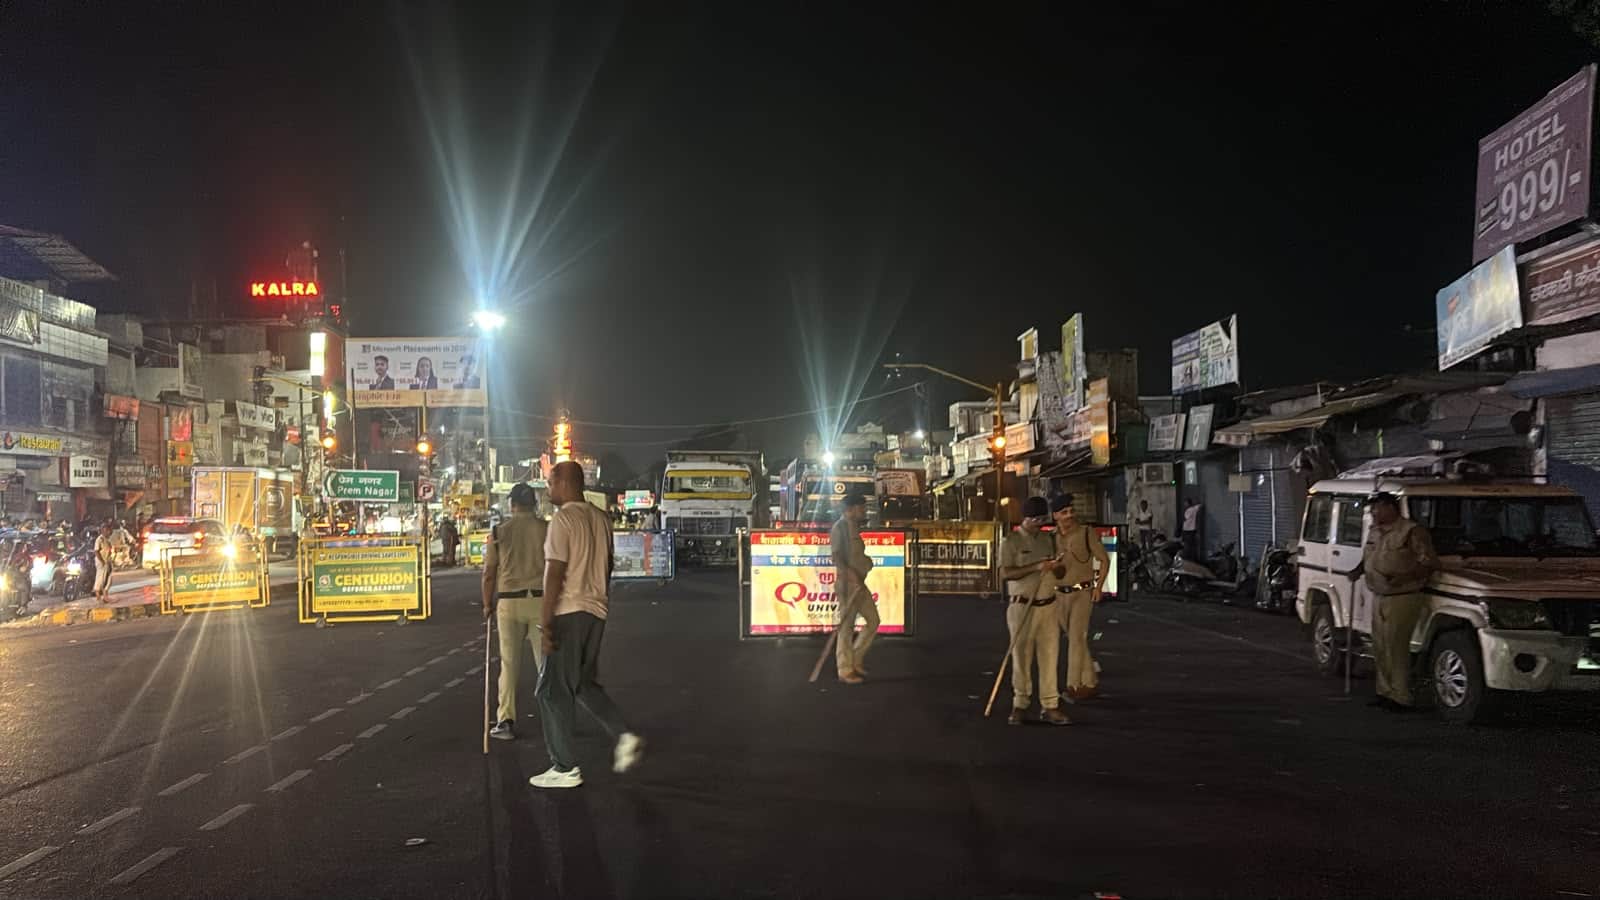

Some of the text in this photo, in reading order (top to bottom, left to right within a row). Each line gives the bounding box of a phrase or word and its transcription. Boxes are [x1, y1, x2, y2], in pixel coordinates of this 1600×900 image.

[1495, 112, 1567, 171] HOTEL
[251, 281, 319, 296] KALRA
[337, 487, 394, 496] Prem Nagar
[937, 544, 985, 560] CHAUPAL
[189, 570, 254, 584] CENTURION
[335, 572, 413, 586] CENTURION
[373, 584, 406, 593] ACADEMY
